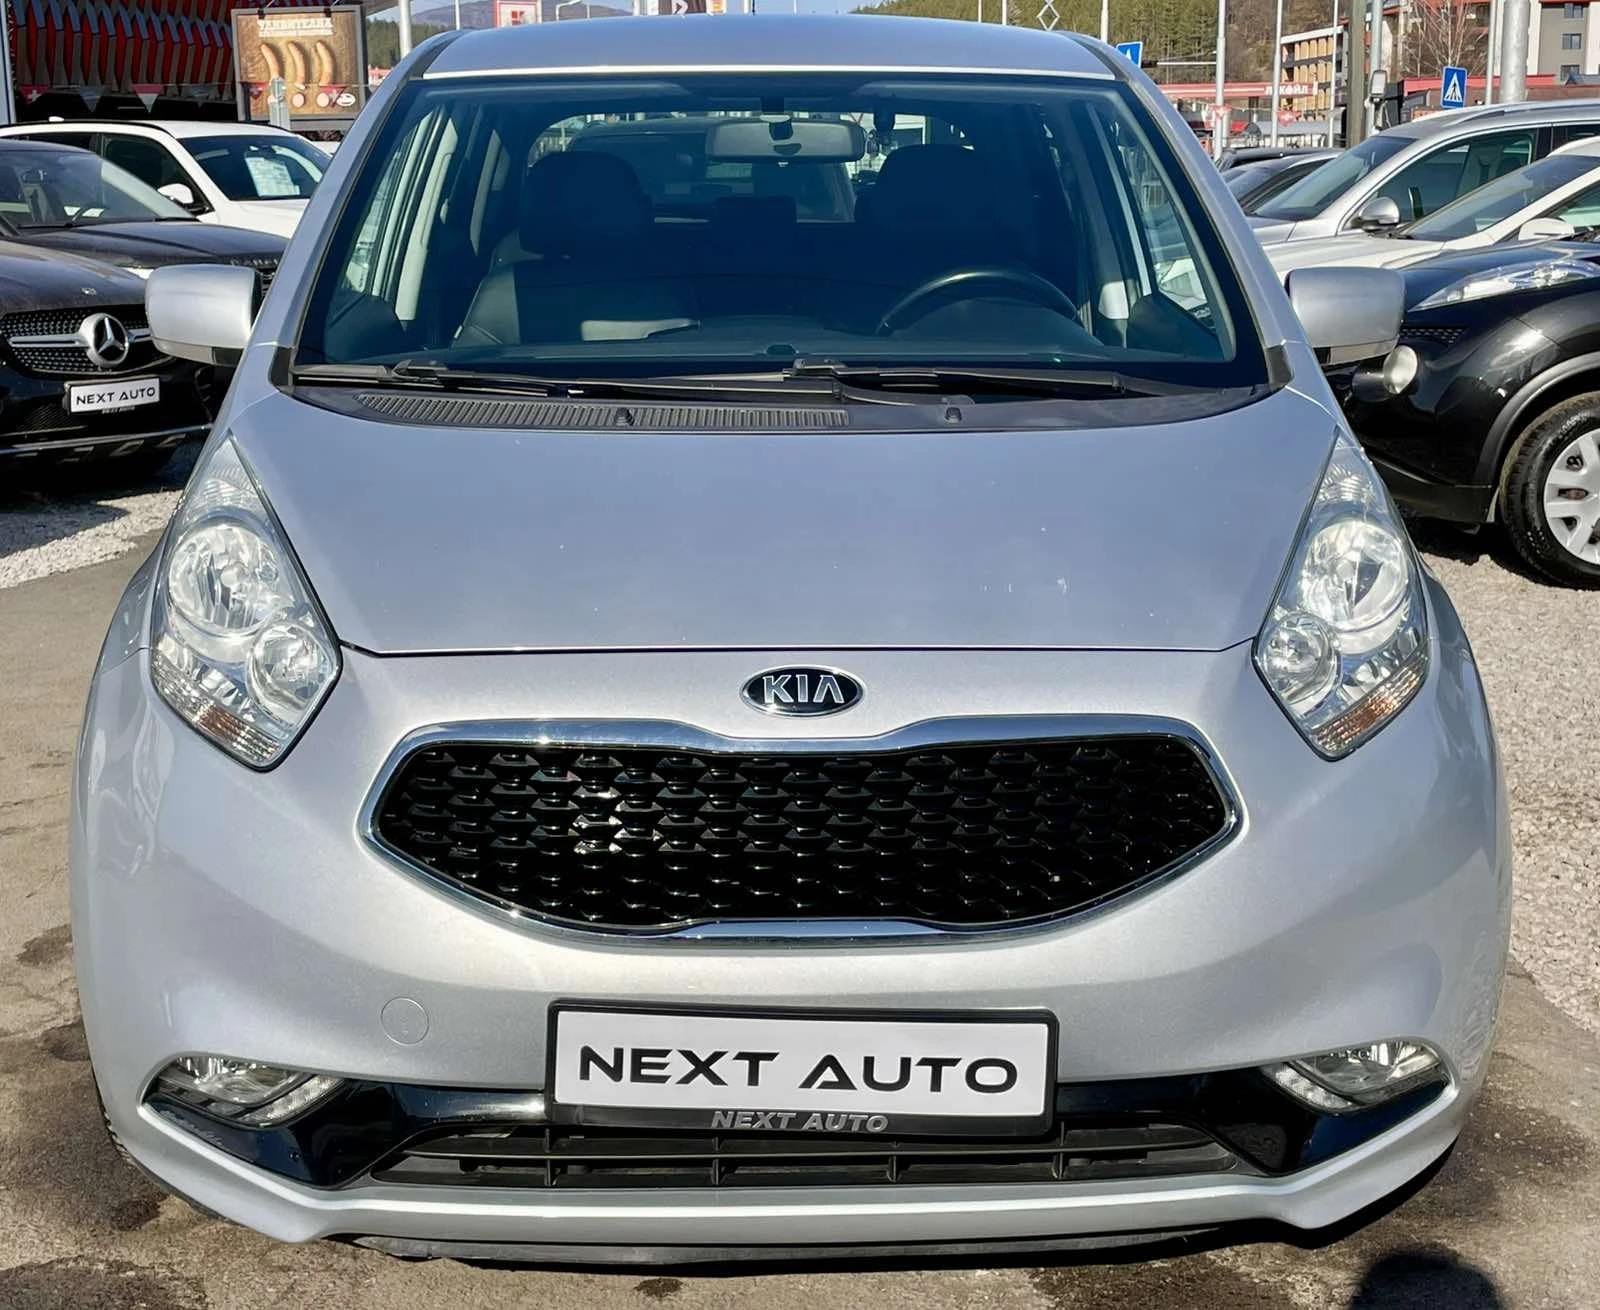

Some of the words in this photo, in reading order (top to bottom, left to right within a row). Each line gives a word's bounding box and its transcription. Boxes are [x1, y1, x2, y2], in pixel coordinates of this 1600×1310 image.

[1264, 83, 1309, 96] ЛКОЙЛ
[76, 391, 115, 405] NEXT
[119, 387, 156, 401] AUTO
[762, 674, 845, 704] KIA
[579, 1045, 780, 1087] NEXT
[798, 1053, 1018, 1094] AUTO
[711, 1110, 797, 1130] NEXT
[801, 1112, 889, 1133] AUTO
